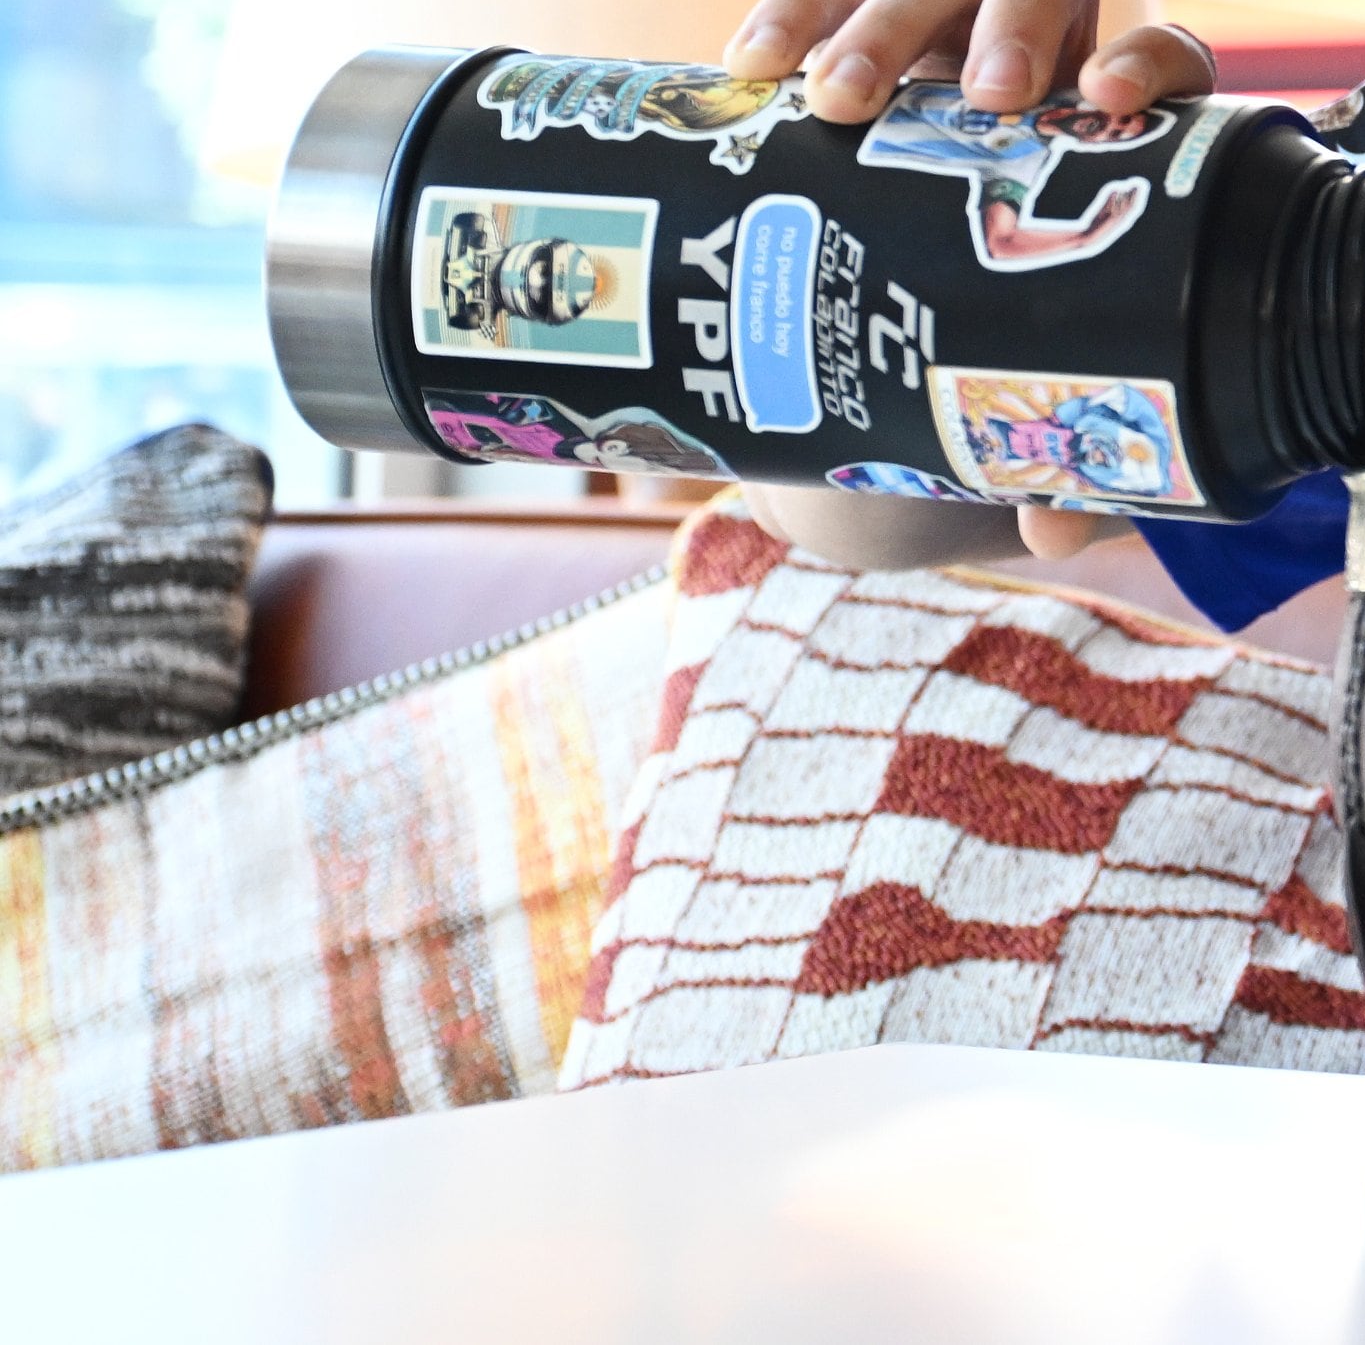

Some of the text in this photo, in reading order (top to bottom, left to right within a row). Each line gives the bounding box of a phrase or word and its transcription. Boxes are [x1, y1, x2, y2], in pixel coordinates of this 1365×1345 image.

[677, 216, 741, 424] YPF
[749, 224, 772, 344] corre franco
[774, 255, 793, 317] puedo
[771, 322, 791, 357] hoy
